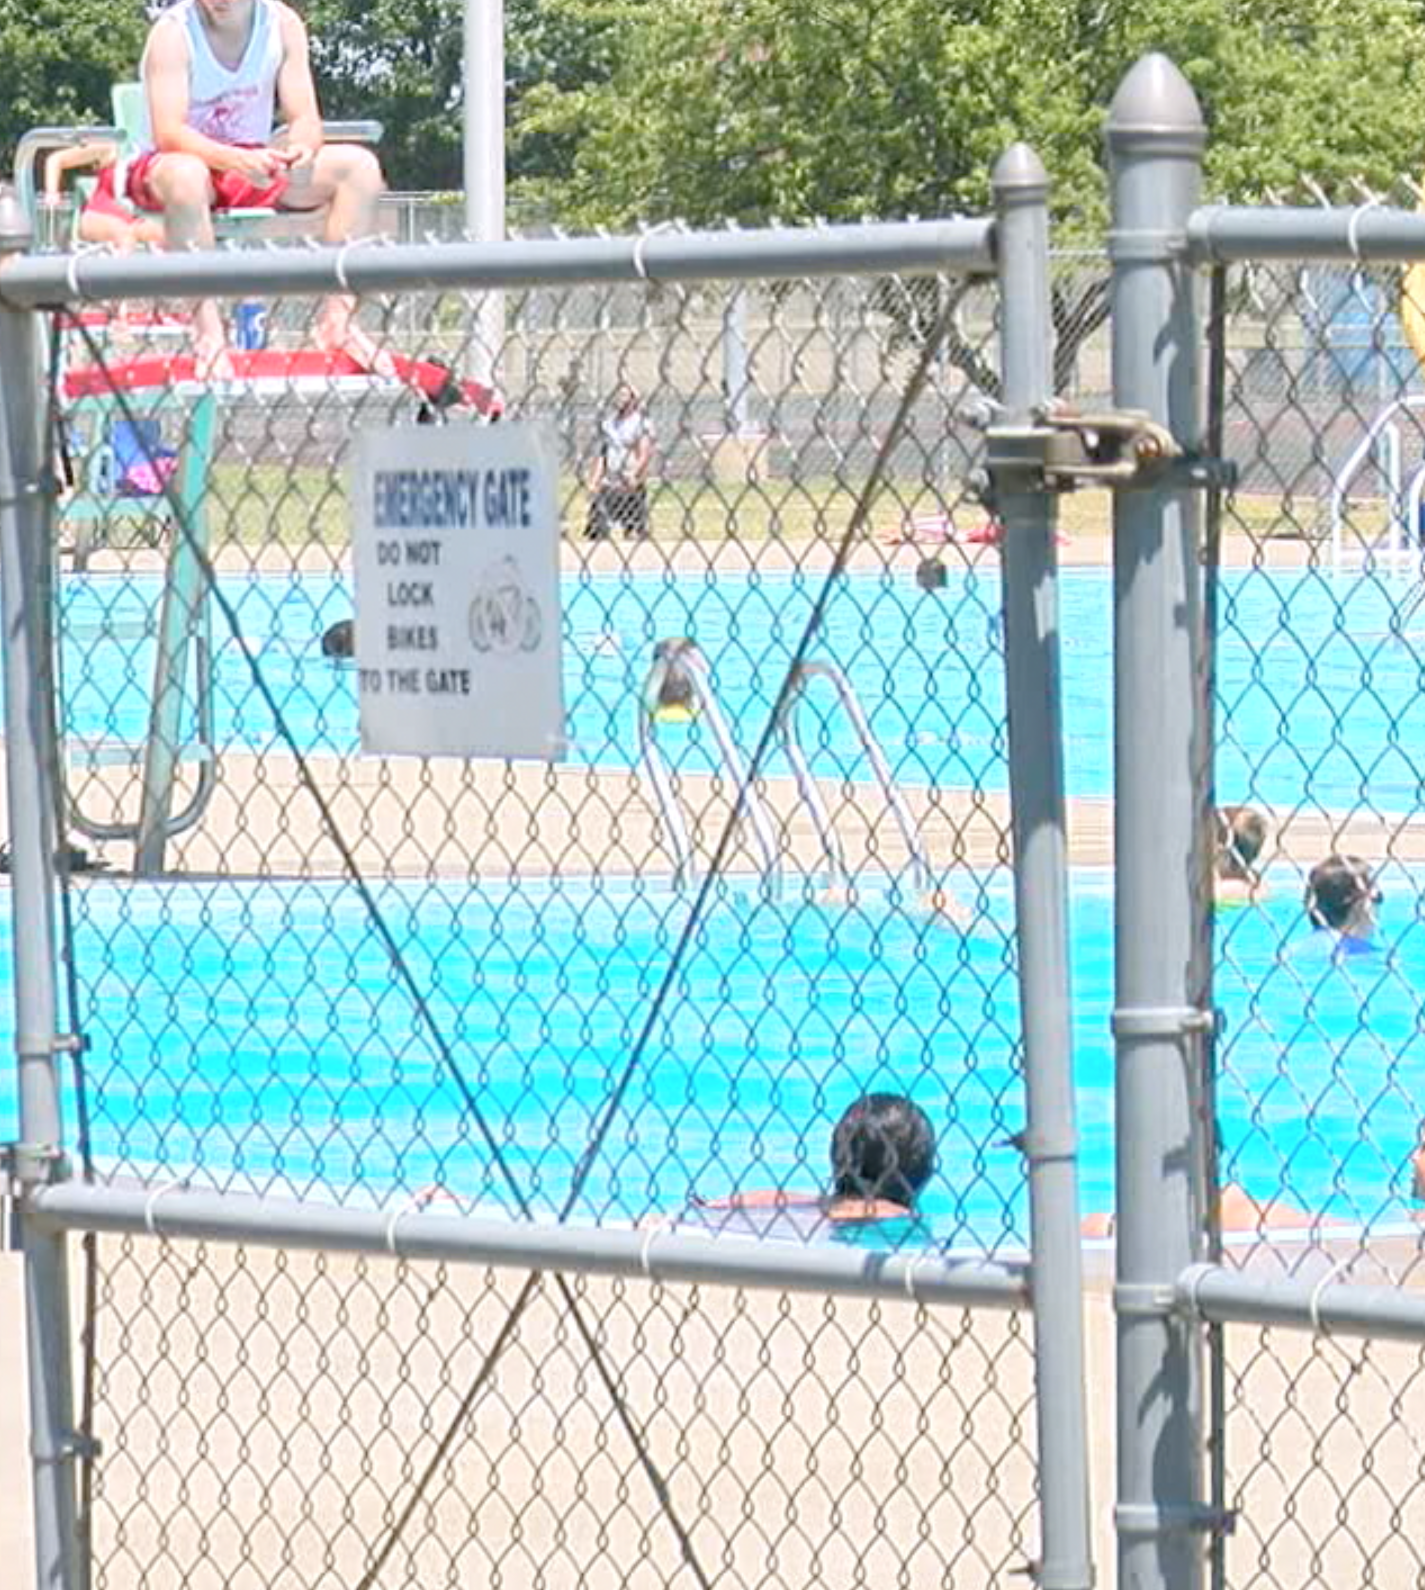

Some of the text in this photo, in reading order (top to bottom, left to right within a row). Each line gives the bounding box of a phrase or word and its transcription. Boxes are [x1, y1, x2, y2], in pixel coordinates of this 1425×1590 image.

[374, 469, 531, 528] EMERGENCY GATE
[377, 541, 441, 566] DO NOT
[387, 582, 433, 607] LOCK
[387, 625, 438, 650] BIKES
[360, 668, 470, 696] TO THE GATE
